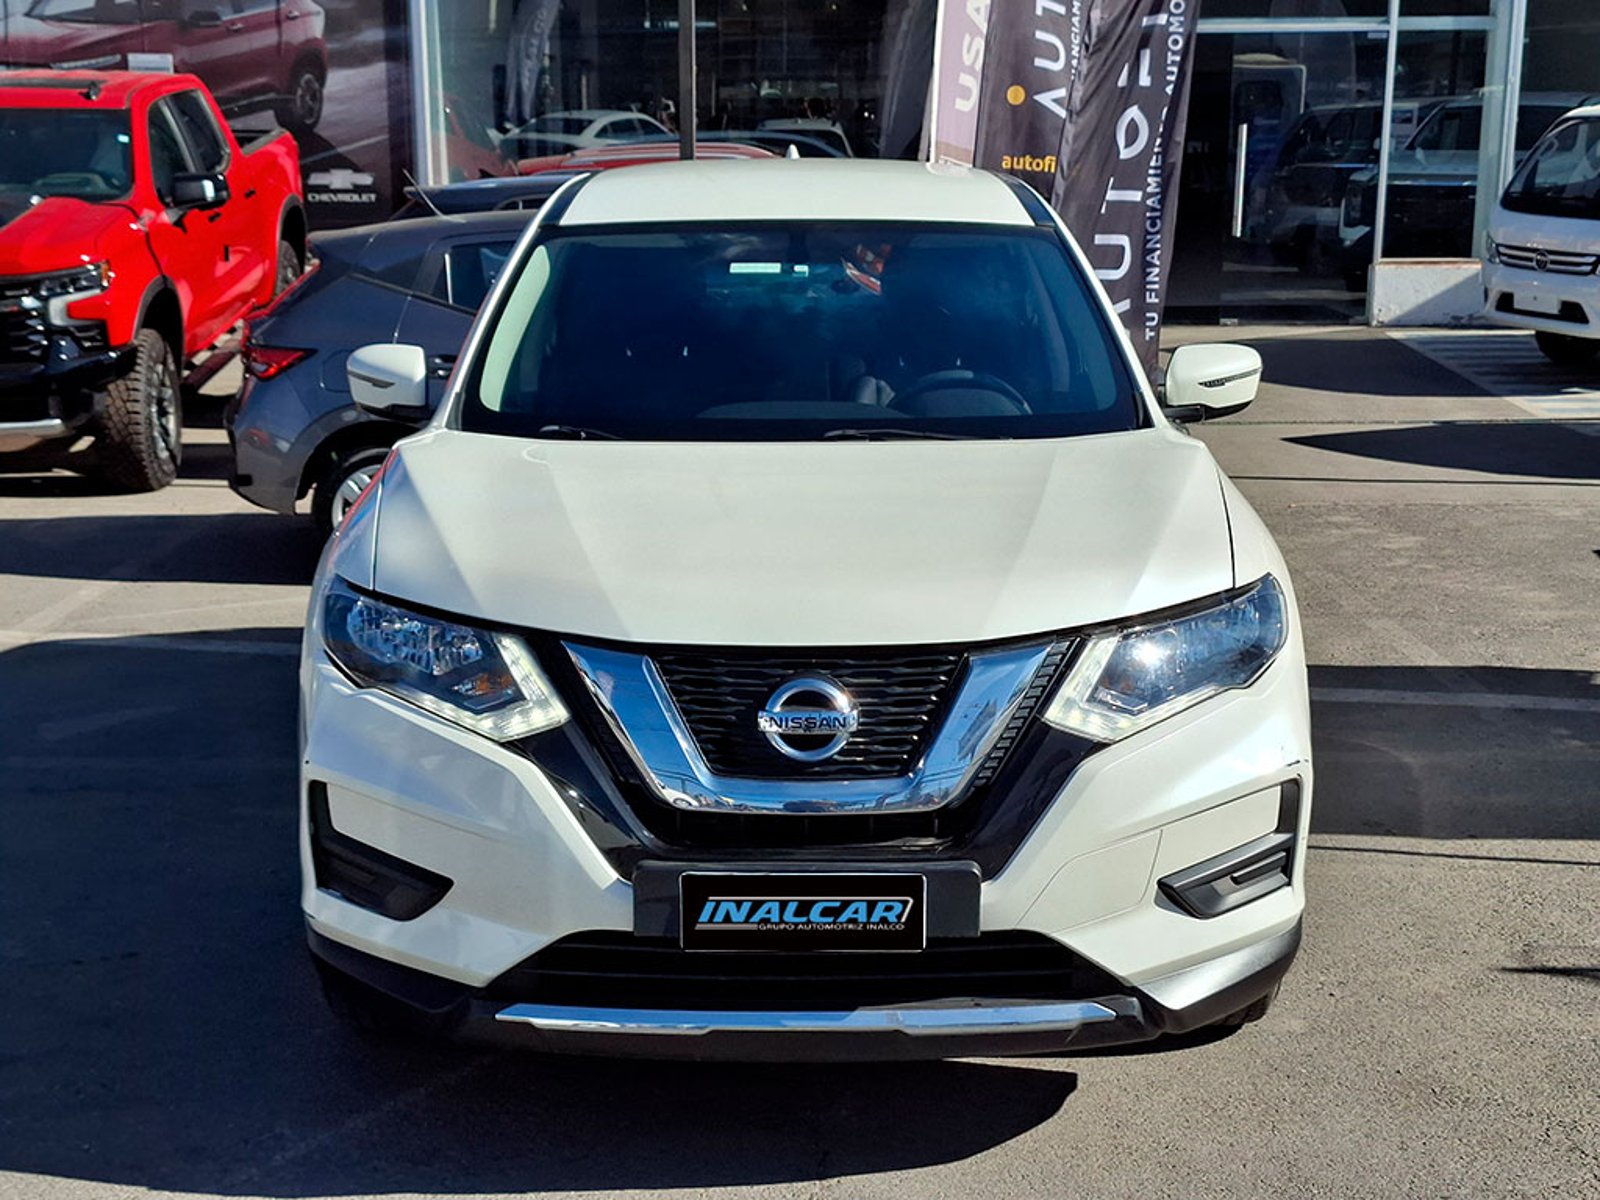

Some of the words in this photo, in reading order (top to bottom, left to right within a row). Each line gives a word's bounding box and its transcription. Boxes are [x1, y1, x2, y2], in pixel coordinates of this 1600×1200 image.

[954, 0, 990, 112] USA
[1145, 313, 1159, 341] TU
[768, 716, 847, 729] NISSAN
